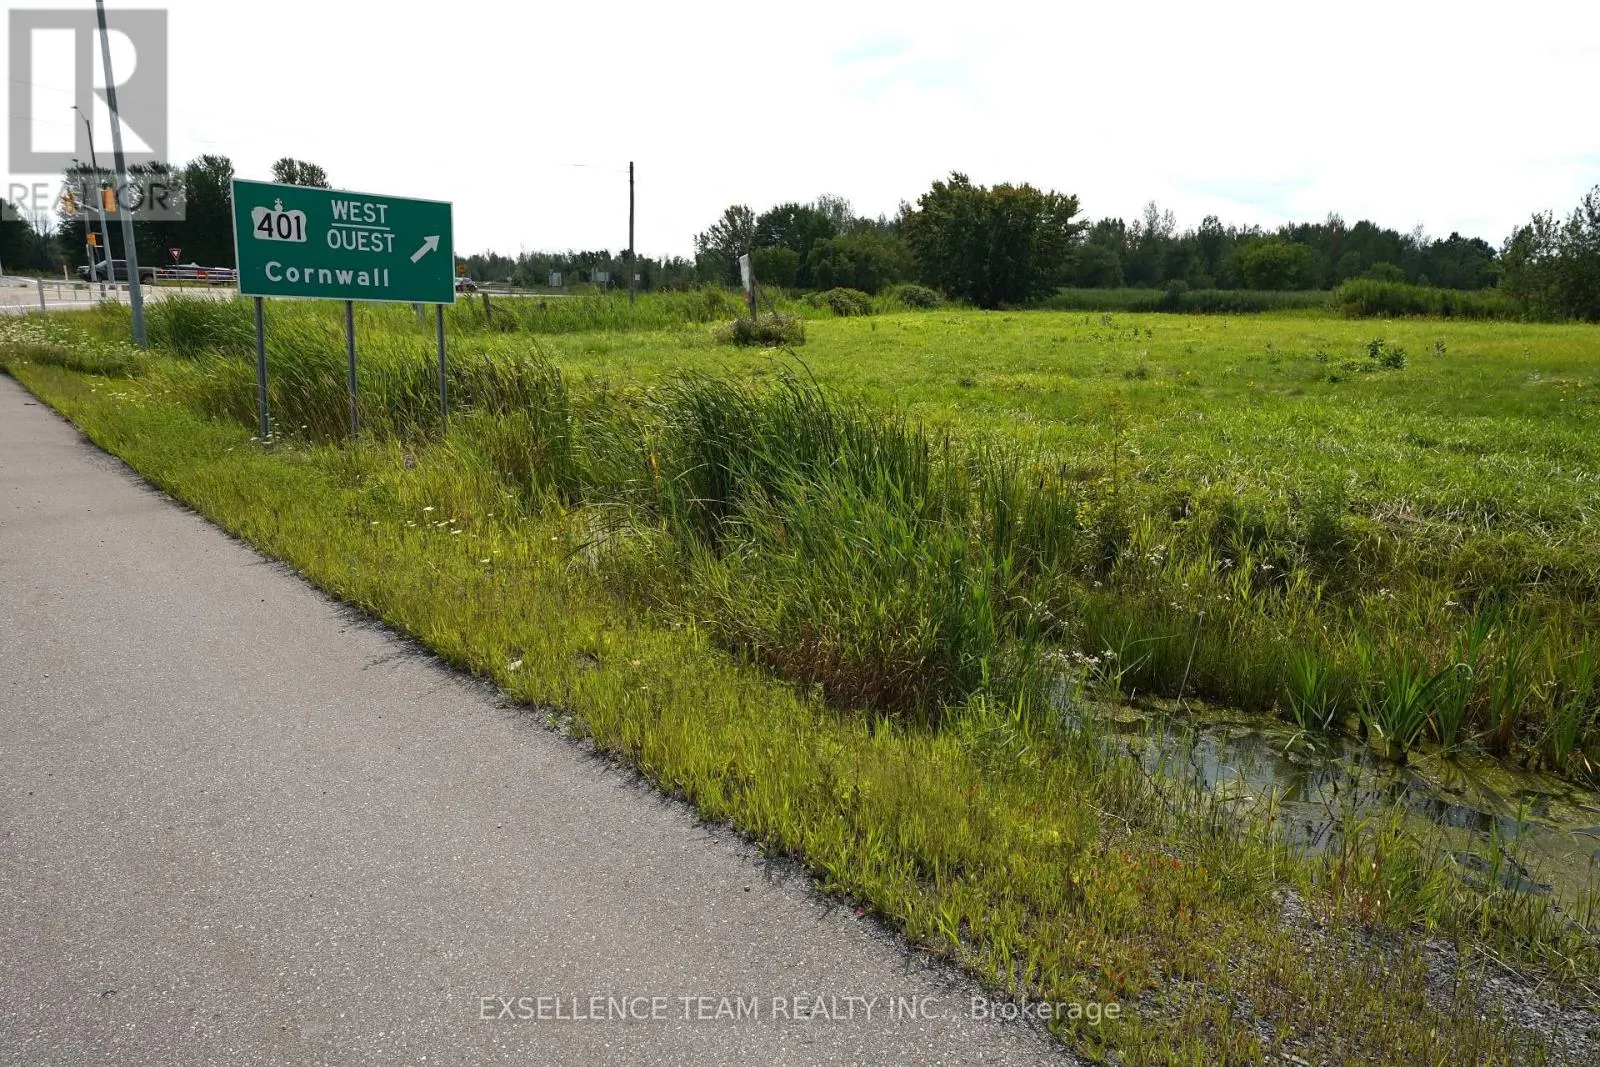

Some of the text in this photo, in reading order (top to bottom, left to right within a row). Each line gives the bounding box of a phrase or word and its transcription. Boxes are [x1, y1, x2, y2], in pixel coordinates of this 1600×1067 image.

[331, 199, 388, 224] WEST
[257, 212, 303, 240] 401
[327, 229, 395, 253] OUEST
[265, 261, 389, 287] Cornwall
